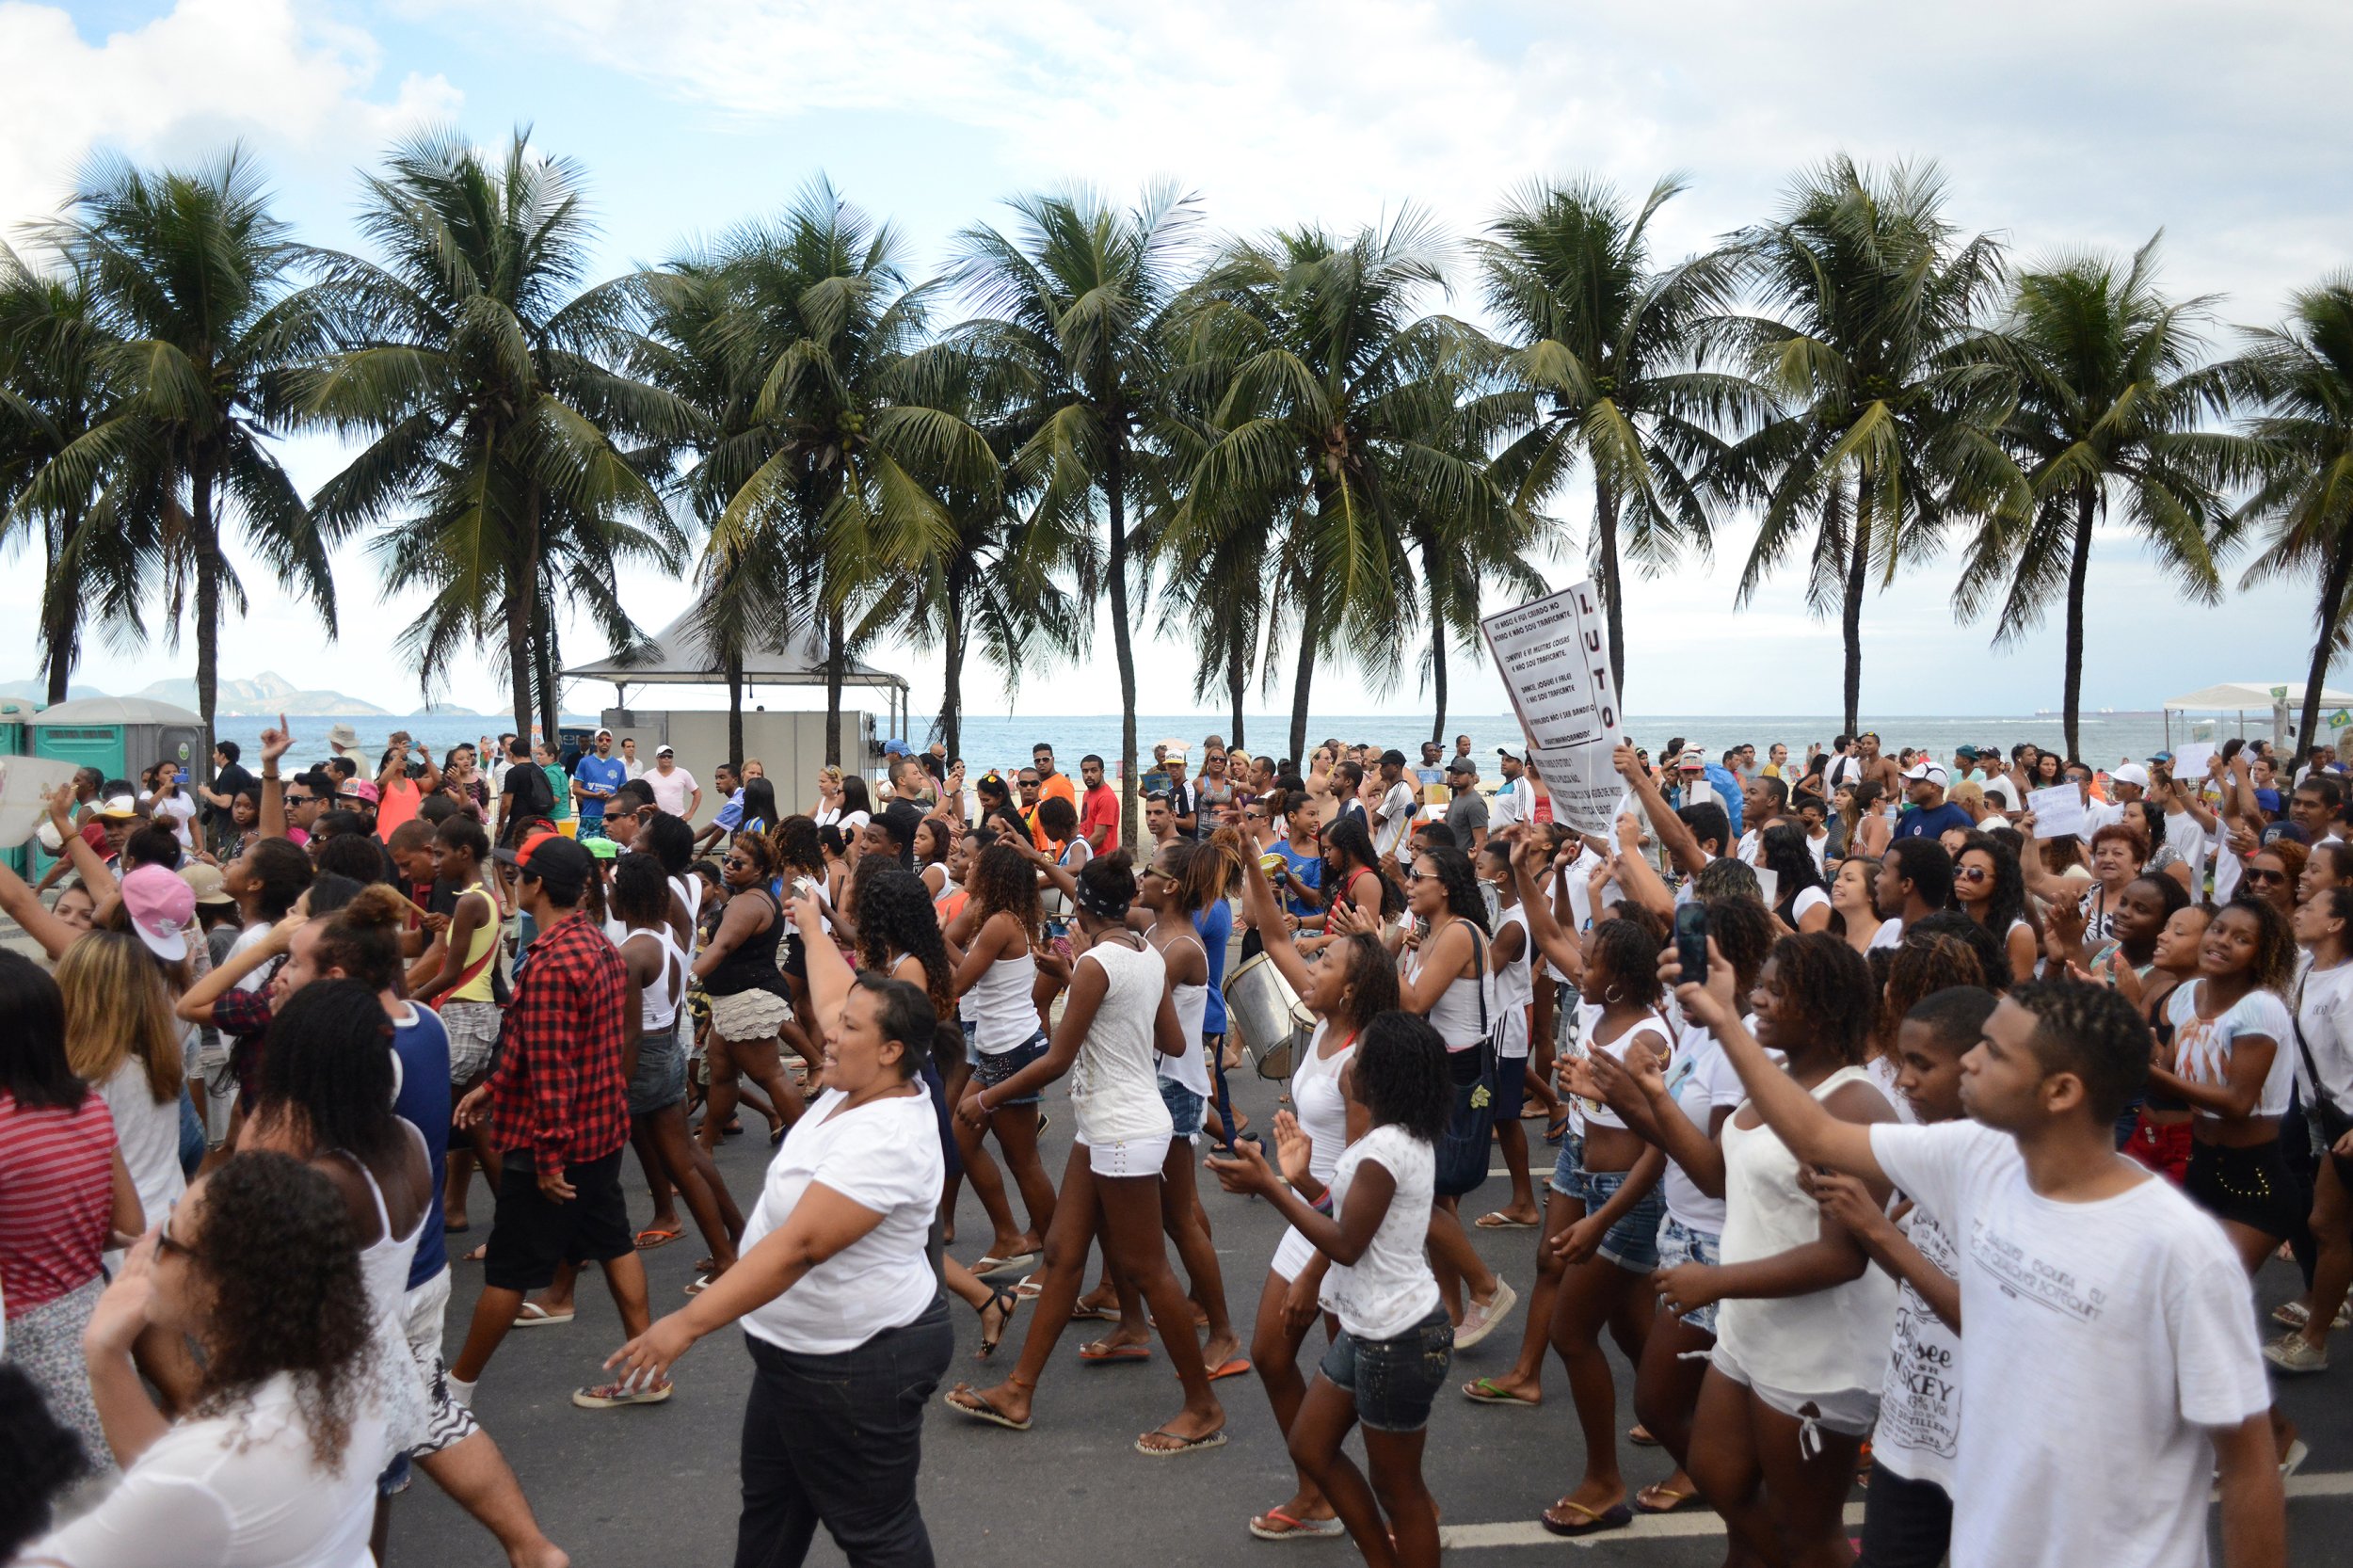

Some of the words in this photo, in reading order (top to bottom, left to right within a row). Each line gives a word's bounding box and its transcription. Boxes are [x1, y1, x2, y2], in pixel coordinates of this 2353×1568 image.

[1500, 618, 1513, 629] NASCI
[1517, 614, 1528, 622] FUI
[1528, 606, 1549, 618] CRIADO
[1513, 625, 1524, 636] NÃO
[1525, 624, 1536, 632] SOU
[1536, 610, 1572, 629] TRAFICANTE.
[1533, 642, 1551, 654] MUITAS
[1552, 635, 1570, 648] COISAS
[1515, 663, 1526, 672] NÃO
[1526, 659, 1536, 668] SOU
[1537, 678, 1555, 689] JOGUEI
[1559, 672, 1572, 683] FALEI
[1538, 693, 1547, 701] SOU
[1547, 684, 1576, 698] TRAFICANTE
[1562, 711, 1573, 719] SER
